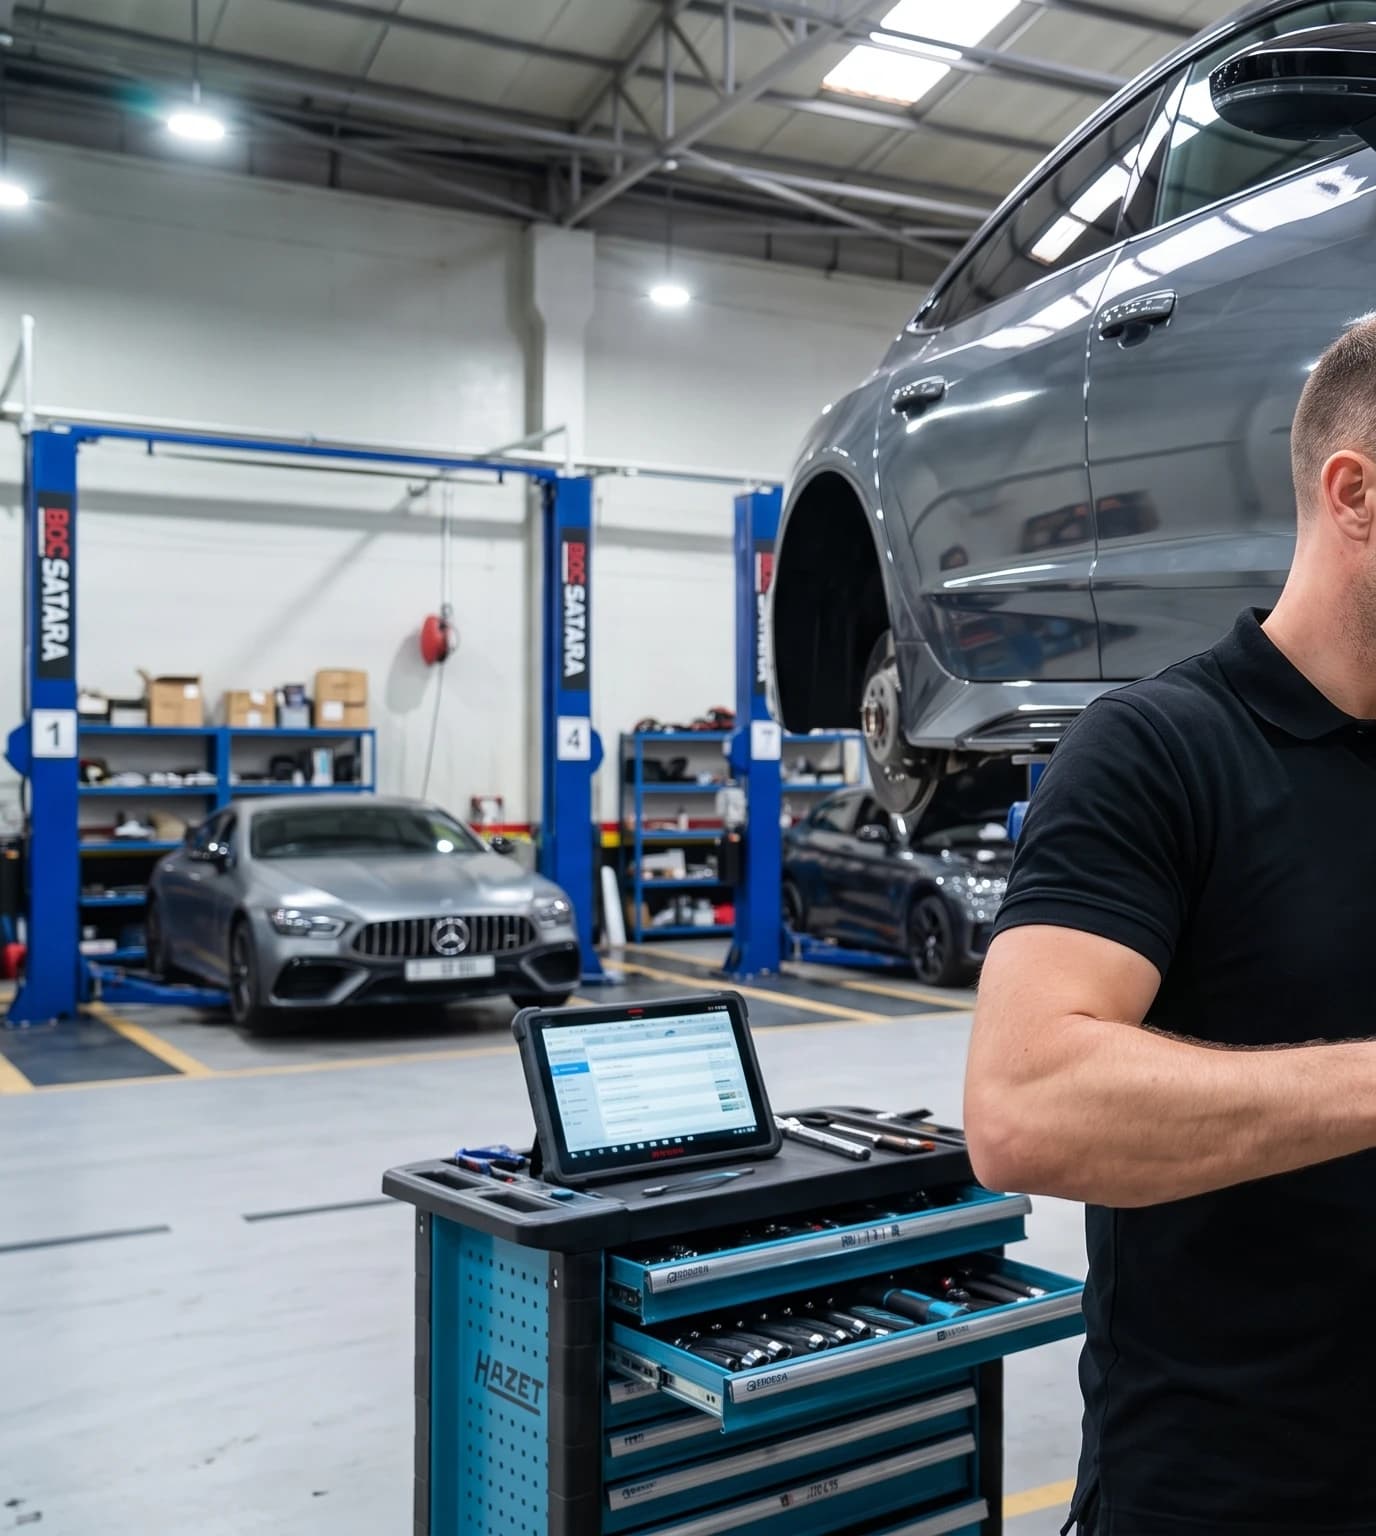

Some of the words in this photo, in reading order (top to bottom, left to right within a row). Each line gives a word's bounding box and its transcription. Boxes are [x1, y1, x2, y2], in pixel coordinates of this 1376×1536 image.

[42, 557, 70, 662] SATARA
[564, 584, 586, 677] SATARA
[46, 721, 59, 747] 1
[567, 729, 580, 750] 4
[474, 1349, 544, 1404] HAZET
